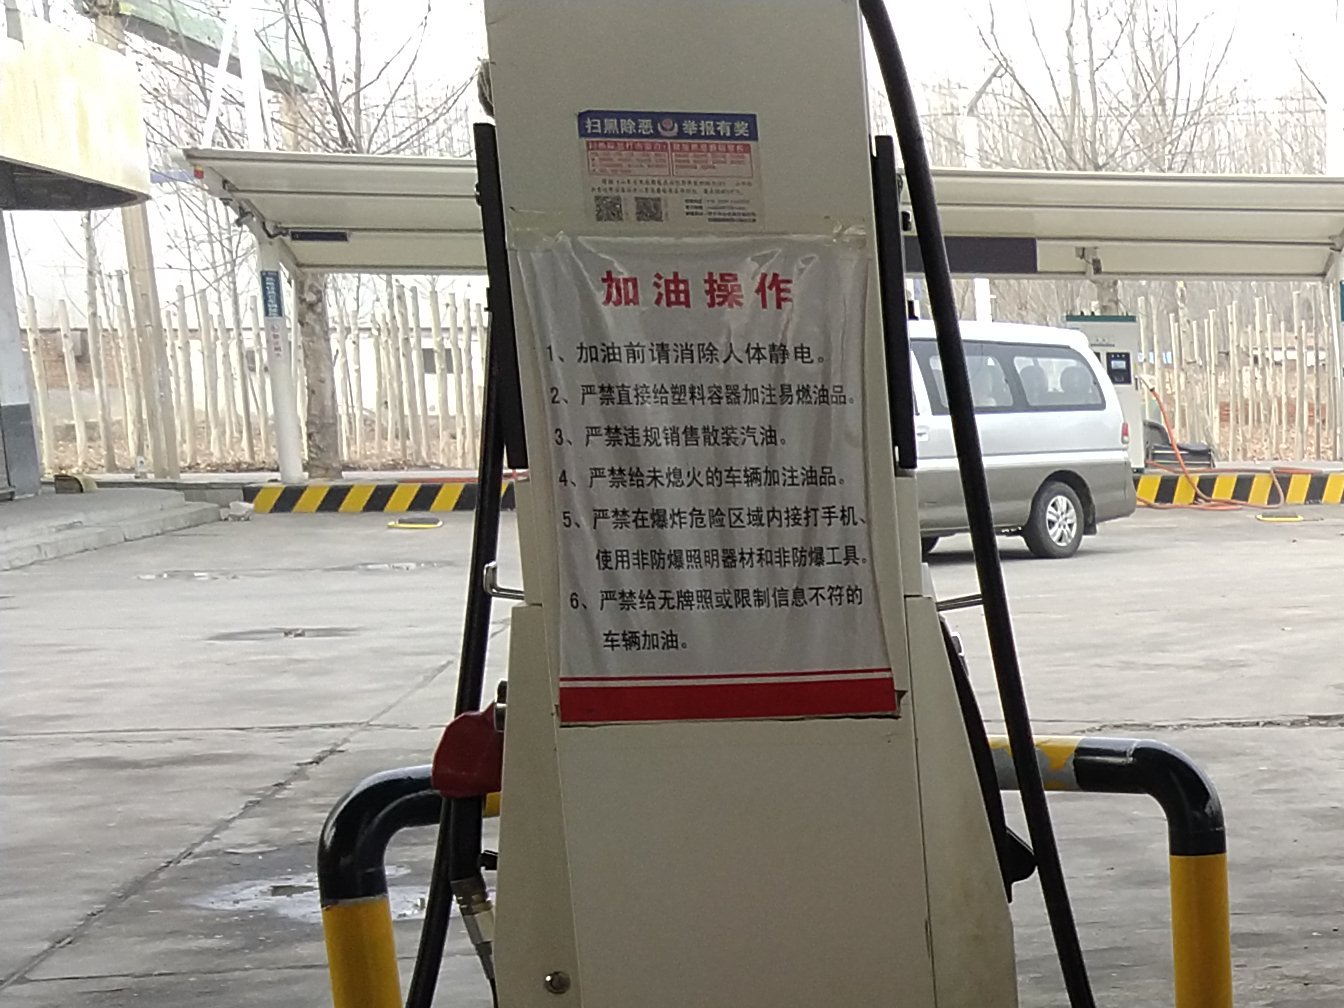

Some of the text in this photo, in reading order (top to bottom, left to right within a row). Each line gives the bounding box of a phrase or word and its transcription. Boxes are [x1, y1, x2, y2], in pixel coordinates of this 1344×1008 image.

[585, 117, 750, 137] 扫黑除恶 举报有奖
[601, 270, 794, 310] 加油操作
[546, 342, 826, 366] 1、加油前请消除人体静电。
[550, 384, 856, 407] 2、严禁直接给塑料容器加注易燃油品。
[554, 425, 788, 447] 3、严禁违规销售散装汽油。
[558, 466, 846, 488] 4、严禁给未熄火的车辆加注油品。
[595, 547, 868, 571] 使用非防爆照明器材和非防爆工具。
[570, 585, 863, 612] 6、严禁给无牌照或限制信息不符的
[603, 630, 688, 652] 车辆加油。
